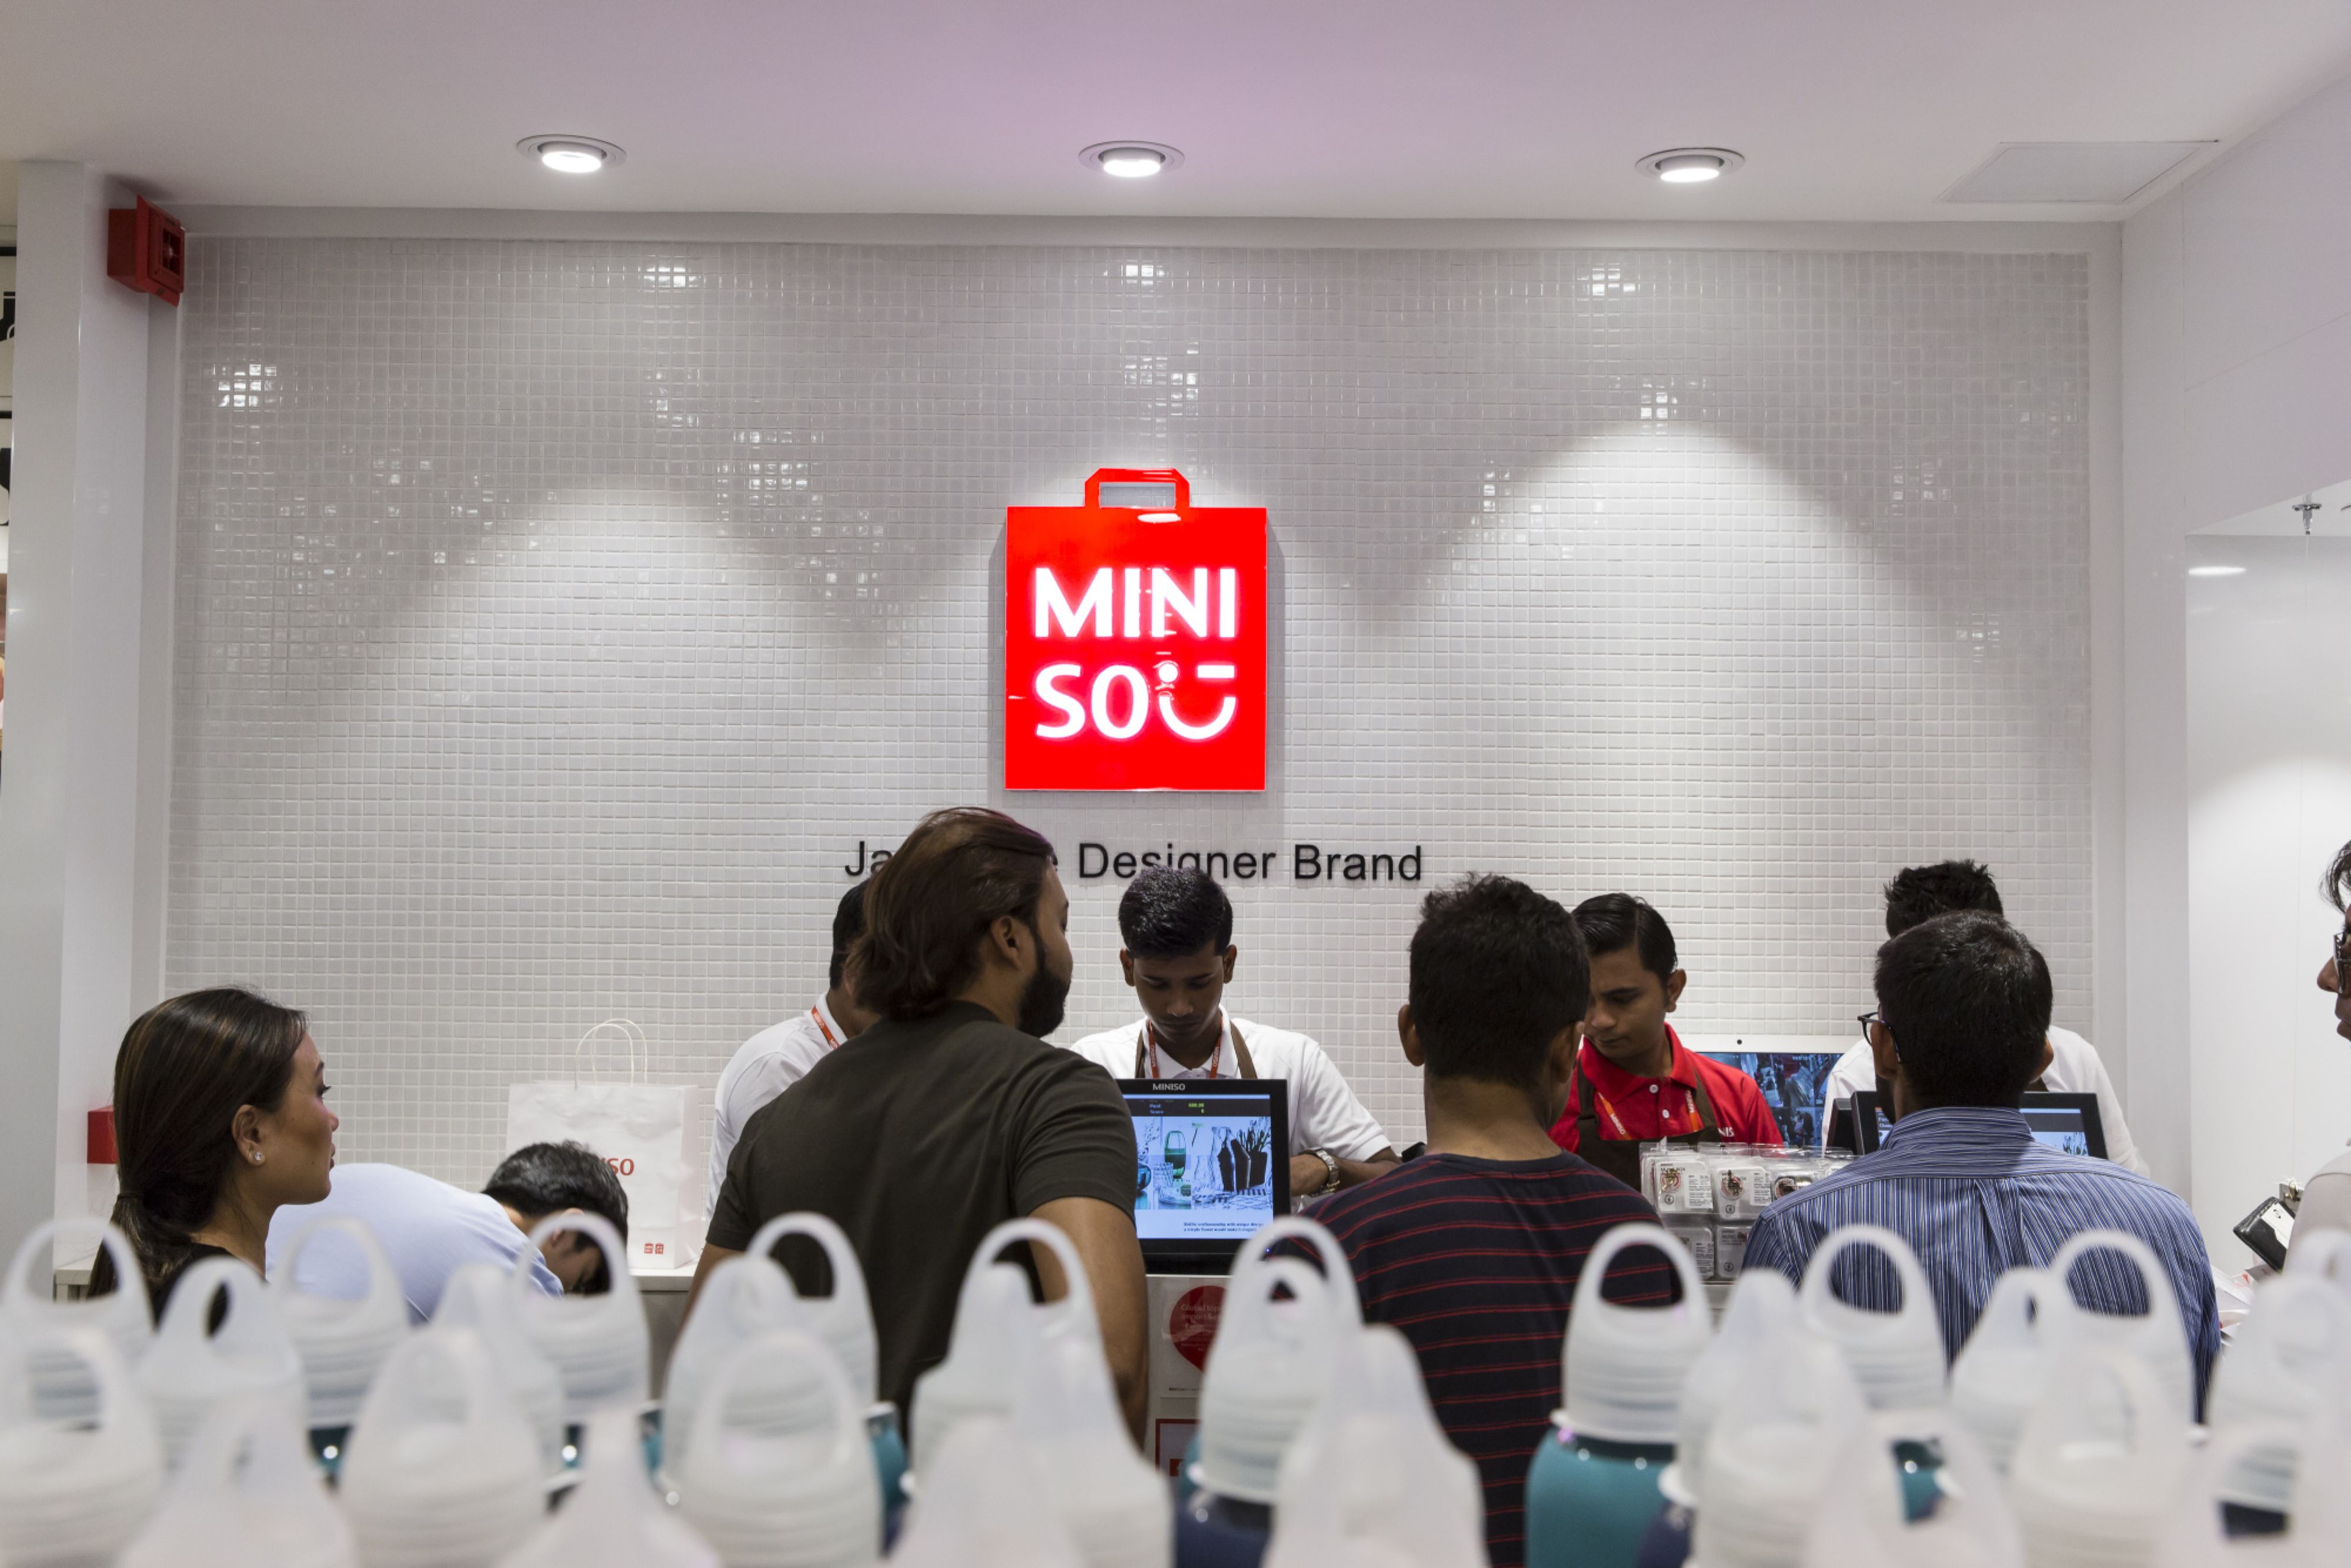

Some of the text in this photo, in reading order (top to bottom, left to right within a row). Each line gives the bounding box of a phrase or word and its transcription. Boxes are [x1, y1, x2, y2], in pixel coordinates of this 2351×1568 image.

[1034, 567, 1236, 637] MINI
[1294, 844, 1421, 881] Brand
[1153, 1083, 1185, 1091] MINISO
[1609, 1113, 1626, 1135] MINISO
